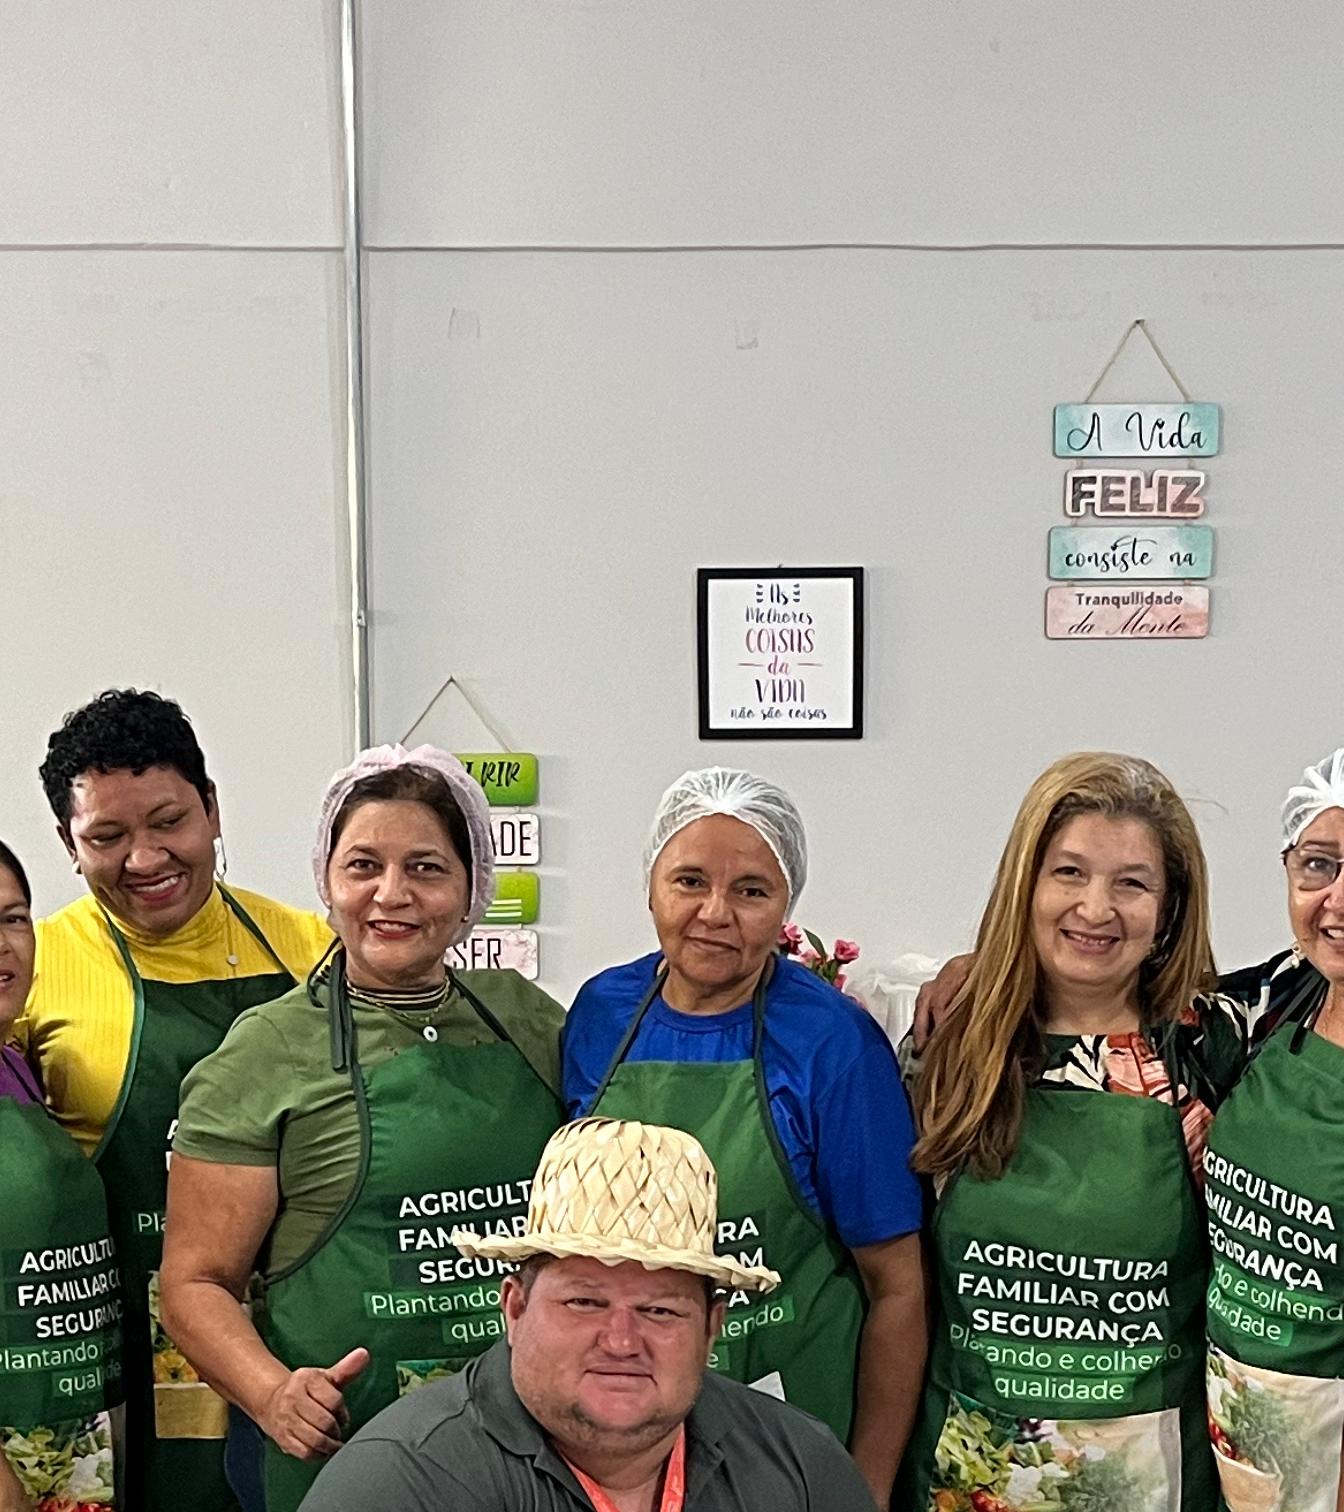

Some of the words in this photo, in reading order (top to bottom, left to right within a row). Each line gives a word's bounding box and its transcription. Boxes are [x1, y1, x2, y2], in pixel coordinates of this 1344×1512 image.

[1066, 411, 1103, 452] A
[1125, 410, 1207, 452] Vida
[1070, 475, 1202, 514] FELIZ
[1064, 535, 1156, 573] consiste
[1169, 550, 1197, 567] na
[1075, 591, 1184, 610] Tranquilidade
[745, 605, 814, 626] Melhores
[1067, 609, 1096, 635] da
[745, 627, 816, 654] COISAS
[767, 654, 790, 677] da
[755, 678, 806, 704] VIDA
[730, 706, 756, 719] não
[760, 706, 783, 721] são
[788, 707, 828, 721] coisas
[481, 761, 521, 788] RIR
[1203, 1145, 1335, 1231] GRICULTURA
[1277, 1225, 1338, 1265] COM
[963, 1240, 1169, 1282] AGRICULTURA
[17, 1273, 110, 1307] FAMILIAR
[371, 1286, 501, 1316] Plantando
[957, 1272, 1100, 1310] FAMILIAR
[1108, 1287, 1171, 1314] COM
[1234, 1279, 1249, 1297] e
[972, 1308, 1164, 1349] SEGURANÇA
[1058, 1352, 1074, 1370] e
[994, 1375, 1125, 1400] qualidade
